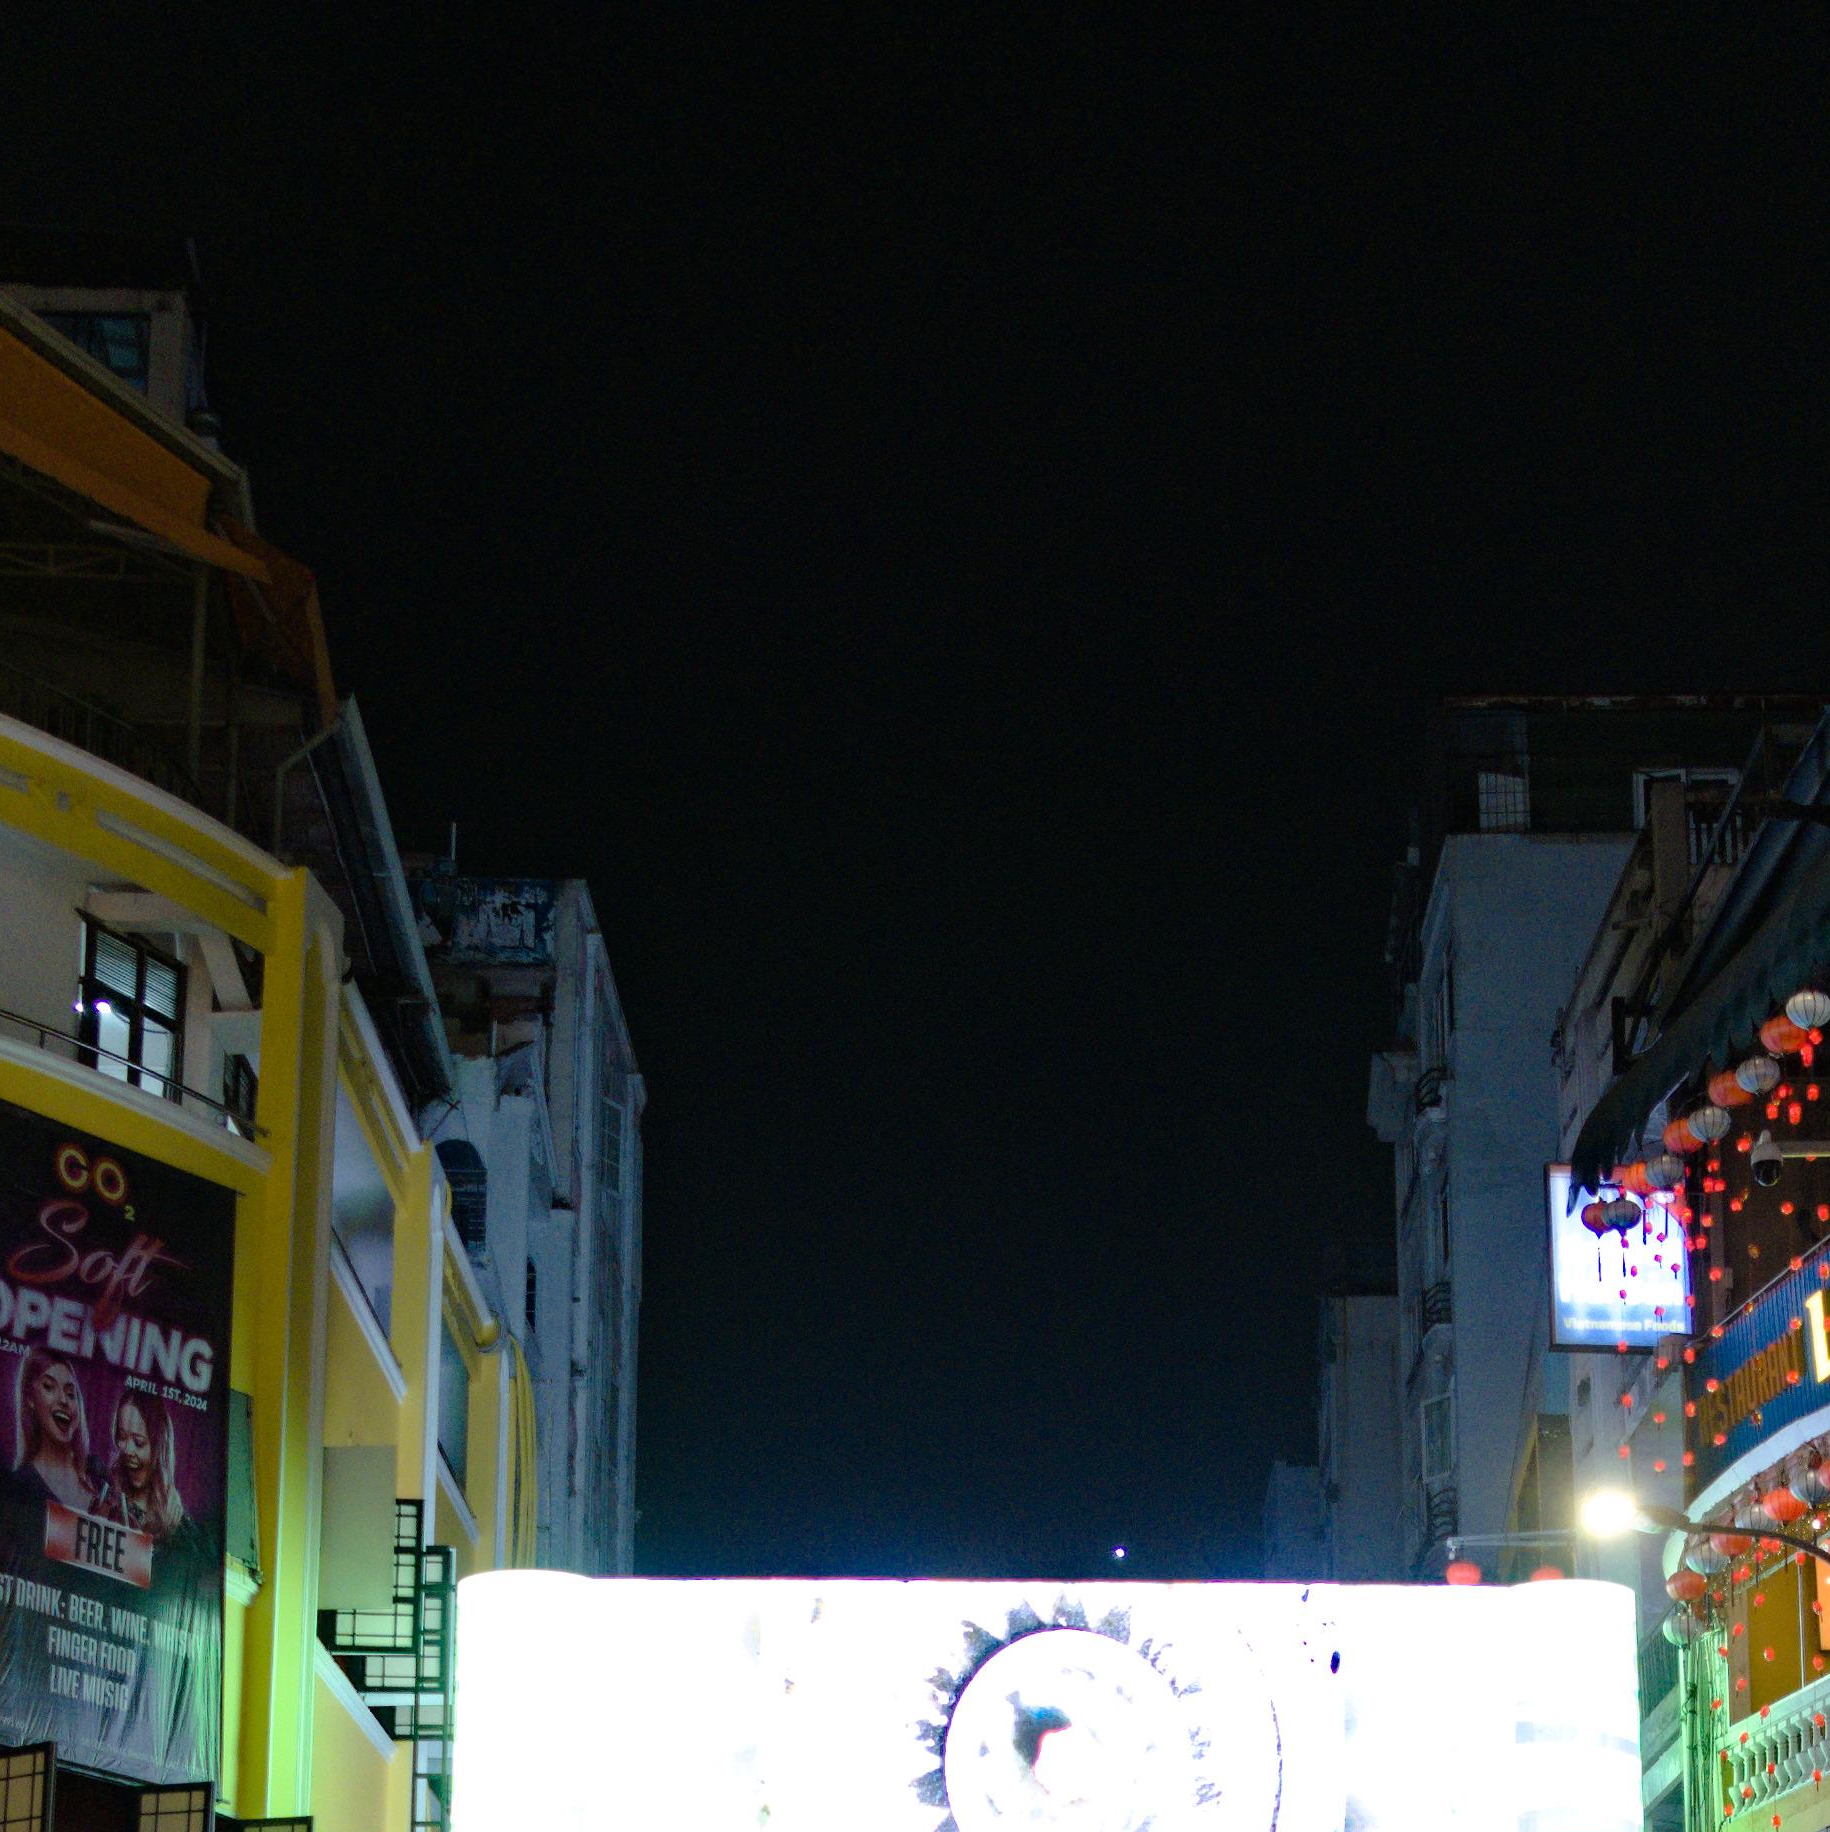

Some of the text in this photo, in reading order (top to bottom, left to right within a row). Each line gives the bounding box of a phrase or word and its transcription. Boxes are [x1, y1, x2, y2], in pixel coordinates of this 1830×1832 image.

[9, 1201, 191, 1328] Soft
[1563, 1316, 1685, 1334] Vietnamese Foods
[124, 1376, 158, 1395] APRIL
[74, 1515, 126, 1574] FREE
[48, 1627, 139, 1677] FINGER FOOD
[50, 1664, 131, 1712] LIVE MUSIC
